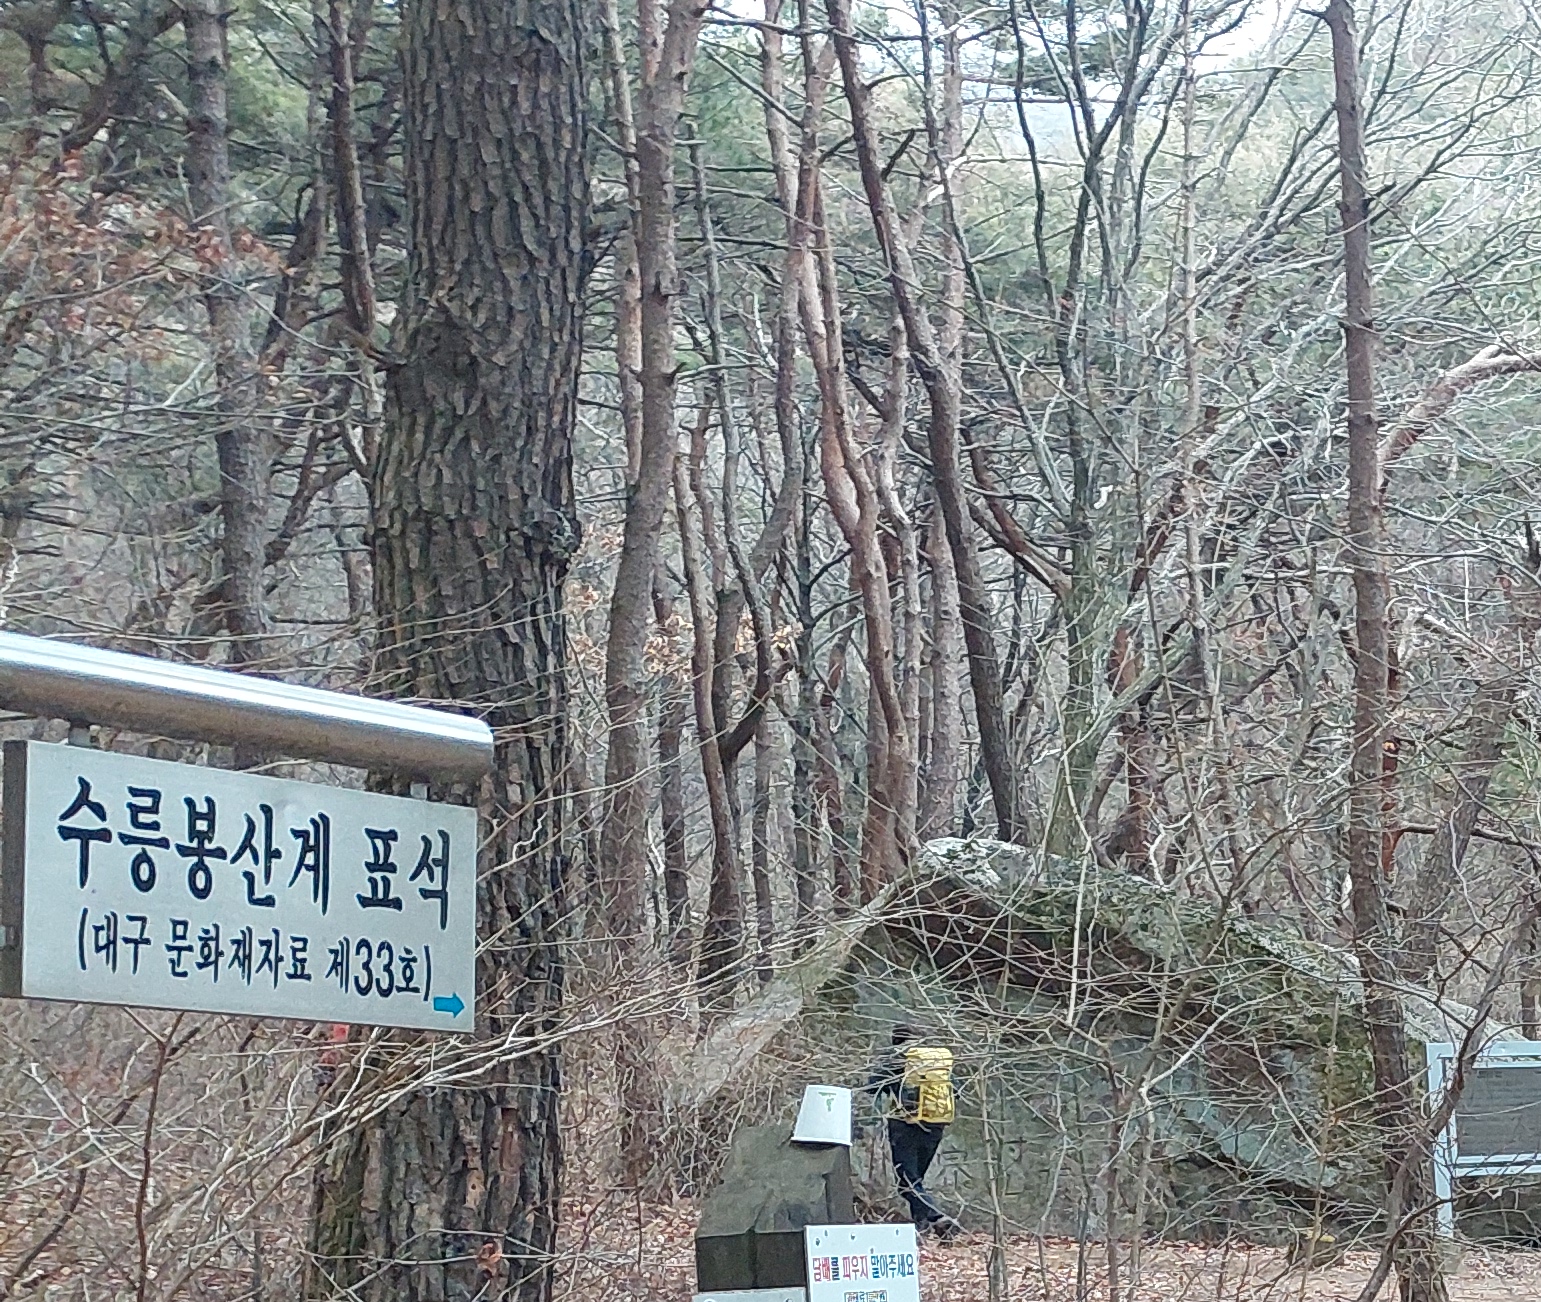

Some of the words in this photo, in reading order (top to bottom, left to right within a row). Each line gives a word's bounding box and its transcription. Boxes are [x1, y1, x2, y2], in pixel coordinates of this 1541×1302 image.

[57, 775, 331, 915] 수릉봉산계
[356, 826, 451, 931] 표석
[78, 906, 152, 975] (대구
[164, 916, 312, 990] 문화재자료
[325, 936, 433, 1002] 제33호)
[812, 1256, 840, 1282] 담배를
[842, 1255, 869, 1280] 피우지
[870, 1253, 914, 1279] 말아주세요
